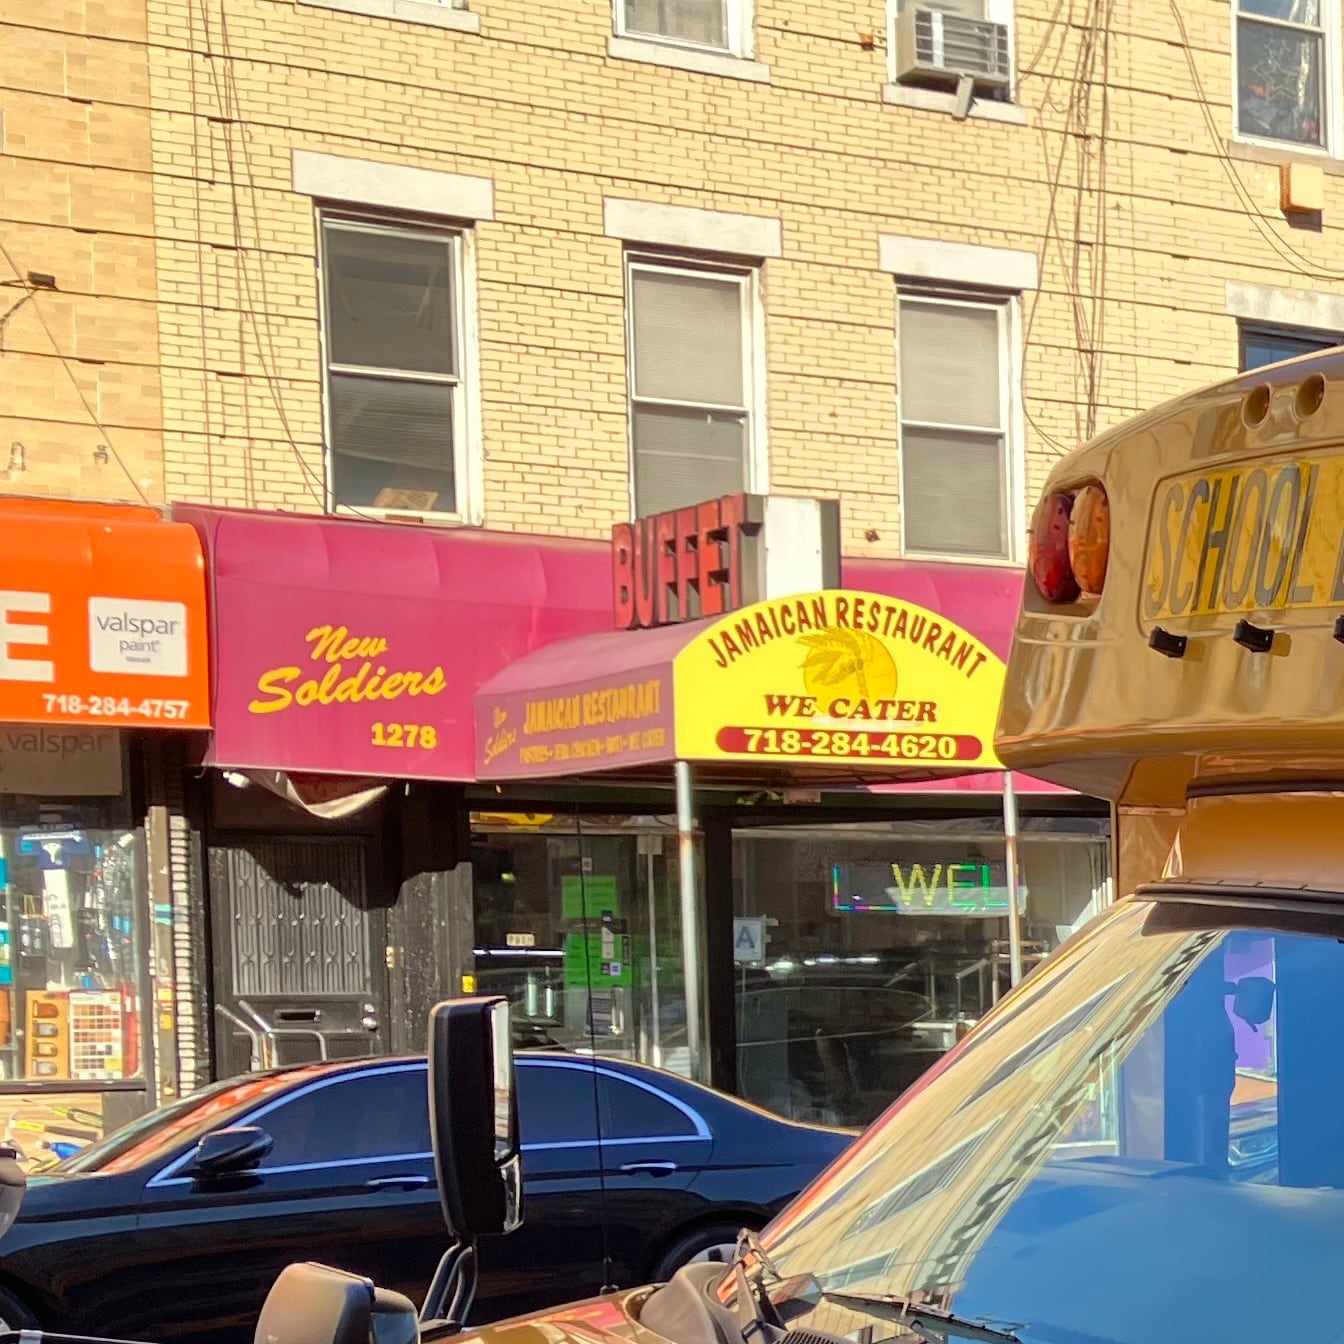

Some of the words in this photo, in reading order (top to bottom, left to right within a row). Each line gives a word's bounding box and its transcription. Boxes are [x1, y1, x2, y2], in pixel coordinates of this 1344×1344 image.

[1144, 462, 1320, 619] SCHOOL
[612, 492, 746, 629] BUFFET
[0, 590, 54, 682] E
[97, 613, 178, 638] valspar
[305, 624, 387, 663] New
[707, 596, 828, 668] JAMAICAN
[835, 596, 987, 679] RESTAURANT
[42, 693, 190, 719] 718-284-4757
[248, 661, 447, 713] Soldiers
[524, 694, 581, 735] JAMAICAN
[583, 680, 661, 726] RESTAURANT
[764, 694, 817, 717] WE
[828, 698, 937, 722] CATER
[8, 728, 108, 759] valspar
[371, 722, 437, 749] 1278
[743, 728, 957, 759] 718-284-4620
[891, 864, 1008, 906] WEL
[735, 926, 755, 948] A
